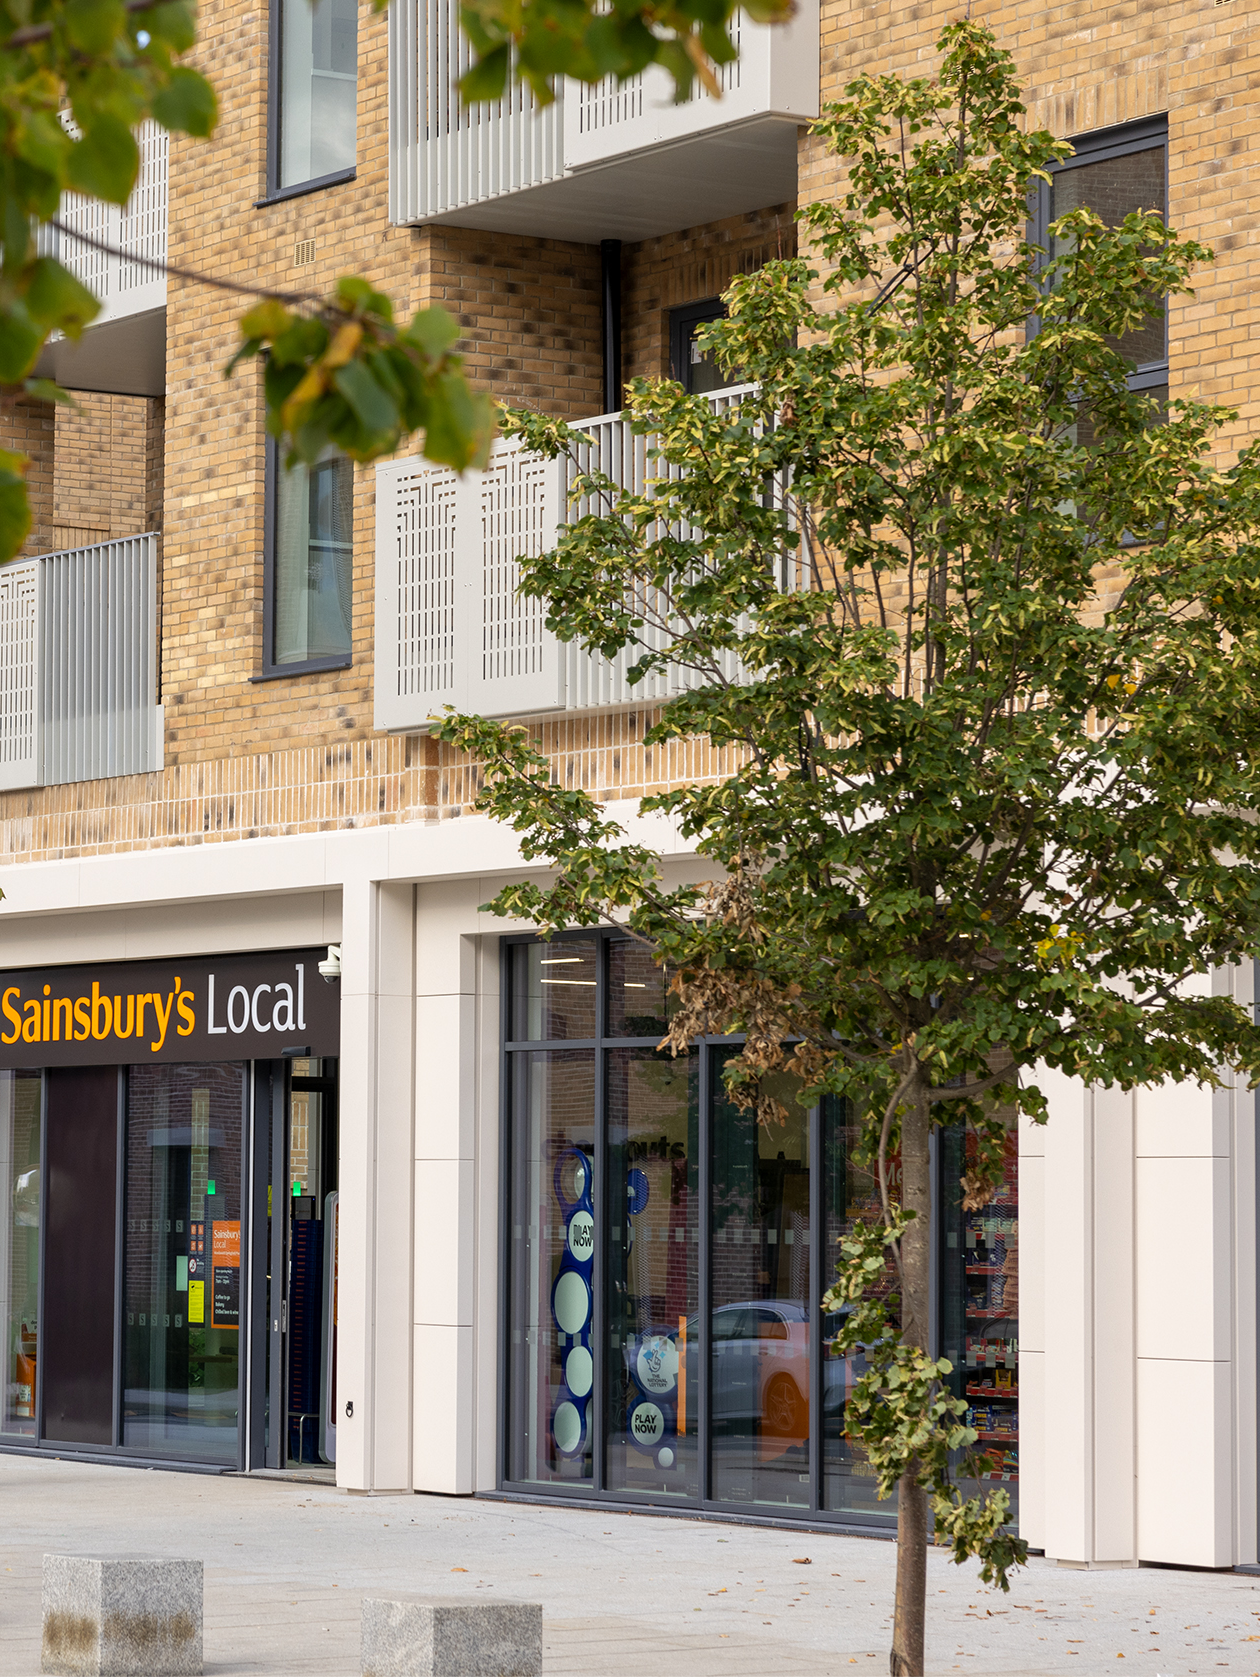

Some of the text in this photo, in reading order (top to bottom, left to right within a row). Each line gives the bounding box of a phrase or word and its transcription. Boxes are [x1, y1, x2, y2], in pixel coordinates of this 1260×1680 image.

[1, 963, 307, 1052] Sainsbury's Local
[214, 1240, 226, 1249] Local
[635, 1414, 657, 1424] PLAY
[635, 1424, 657, 1434] NOW
